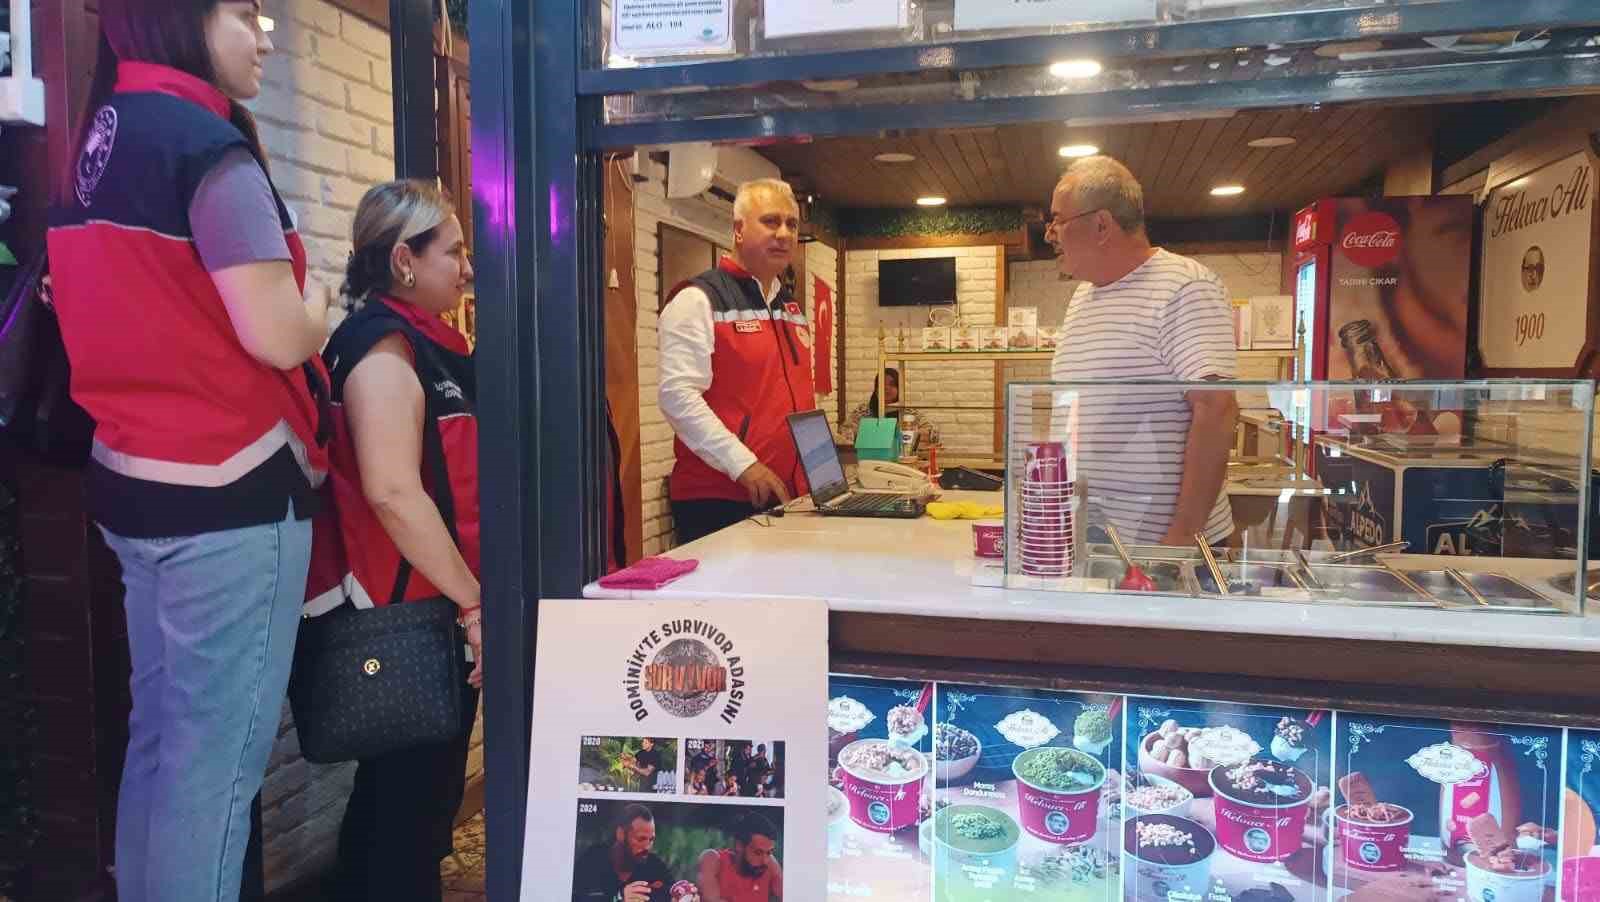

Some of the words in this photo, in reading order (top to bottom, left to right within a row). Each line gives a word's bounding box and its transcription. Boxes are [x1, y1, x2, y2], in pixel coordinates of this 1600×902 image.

[1343, 231, 1399, 249] Coca-Cola
[1514, 312, 1545, 346] 1900
[622, 630, 661, 722] DOMİNİK'TE
[662, 619, 733, 654] SURVIVOR
[720, 655, 745, 724] ADASINI
[644, 664, 727, 692] SURVIVOR
[579, 804, 598, 813] 2024
